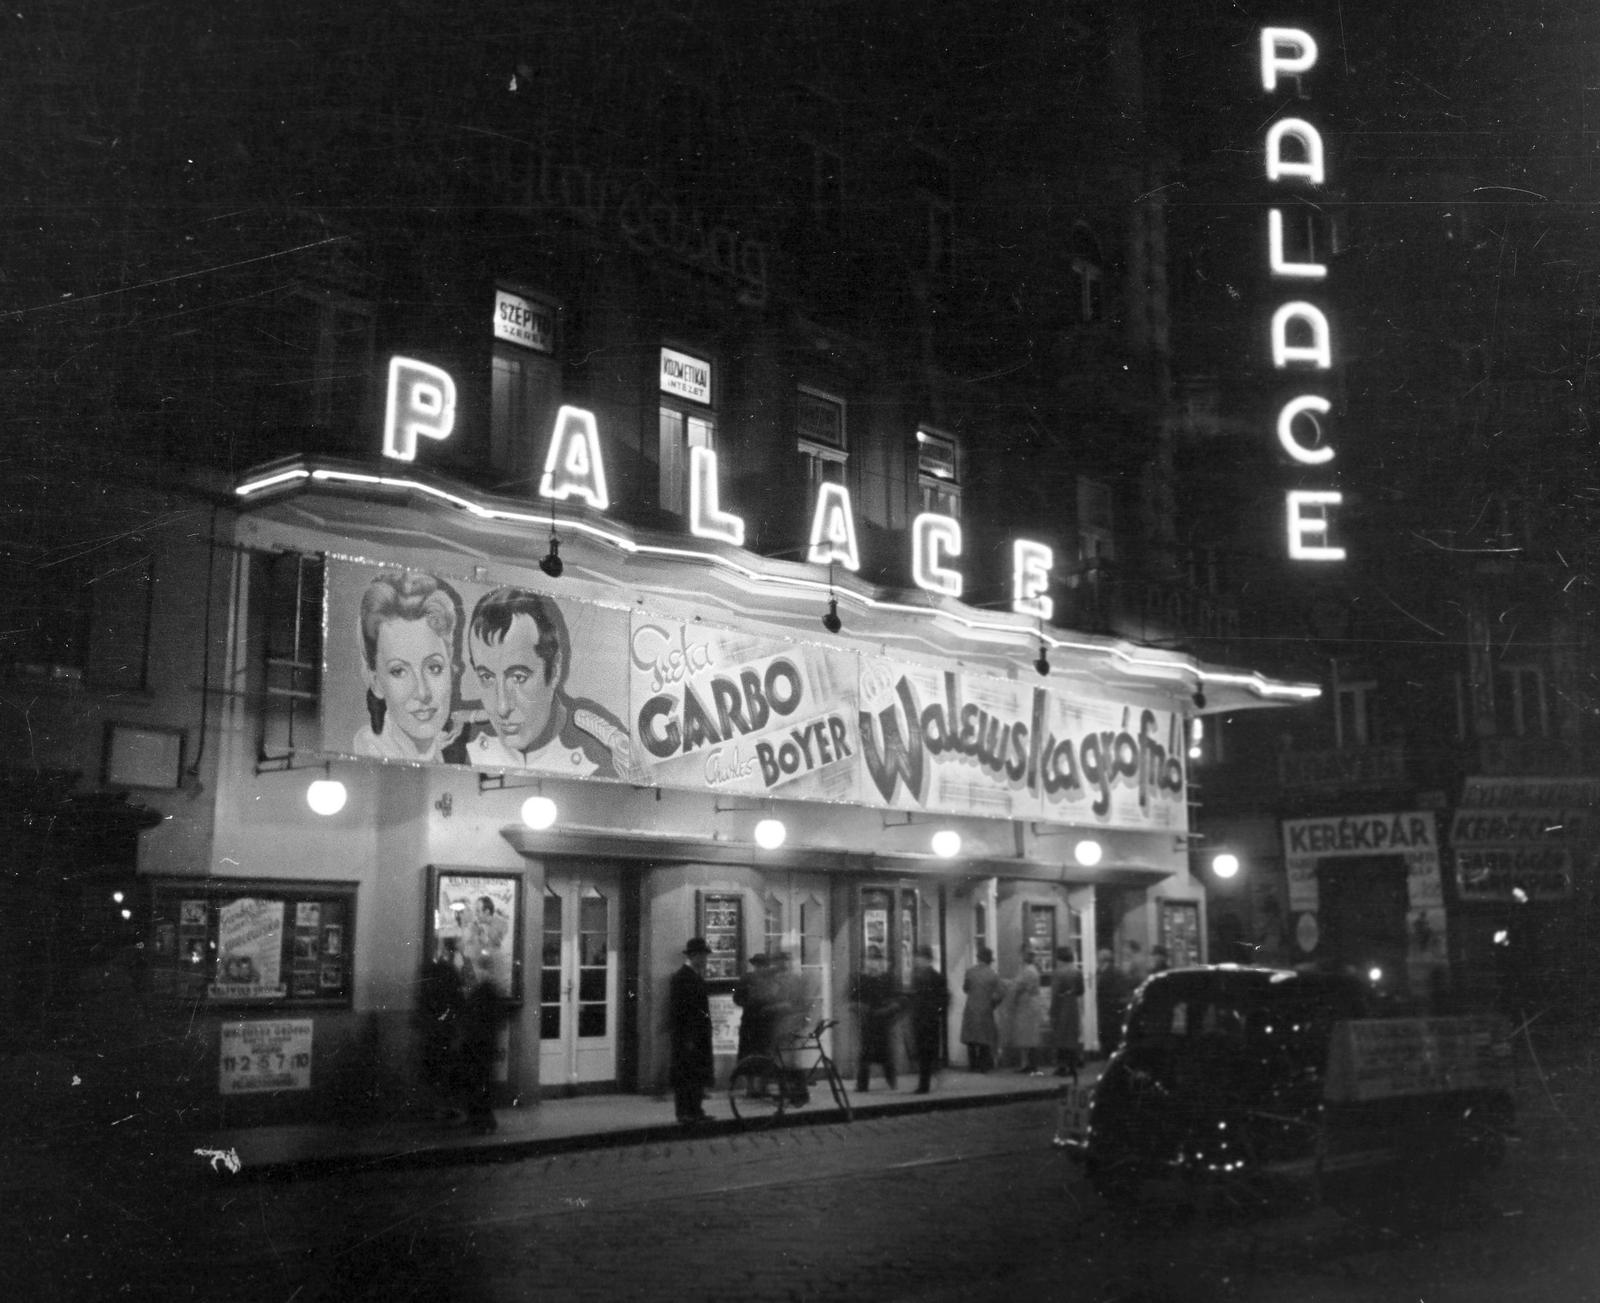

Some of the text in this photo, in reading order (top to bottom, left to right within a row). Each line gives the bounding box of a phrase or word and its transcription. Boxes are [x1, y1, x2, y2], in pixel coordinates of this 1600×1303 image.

[1260, 27, 1346, 561] PALACE
[383, 354, 1053, 621] PALACE
[632, 624, 713, 693] Greta
[638, 657, 803, 758] GARBO
[756, 713, 852, 788] BOYER
[858, 671, 1184, 819] Walewska grófnő
[1289, 814, 1429, 851] KERÉKPÁR
